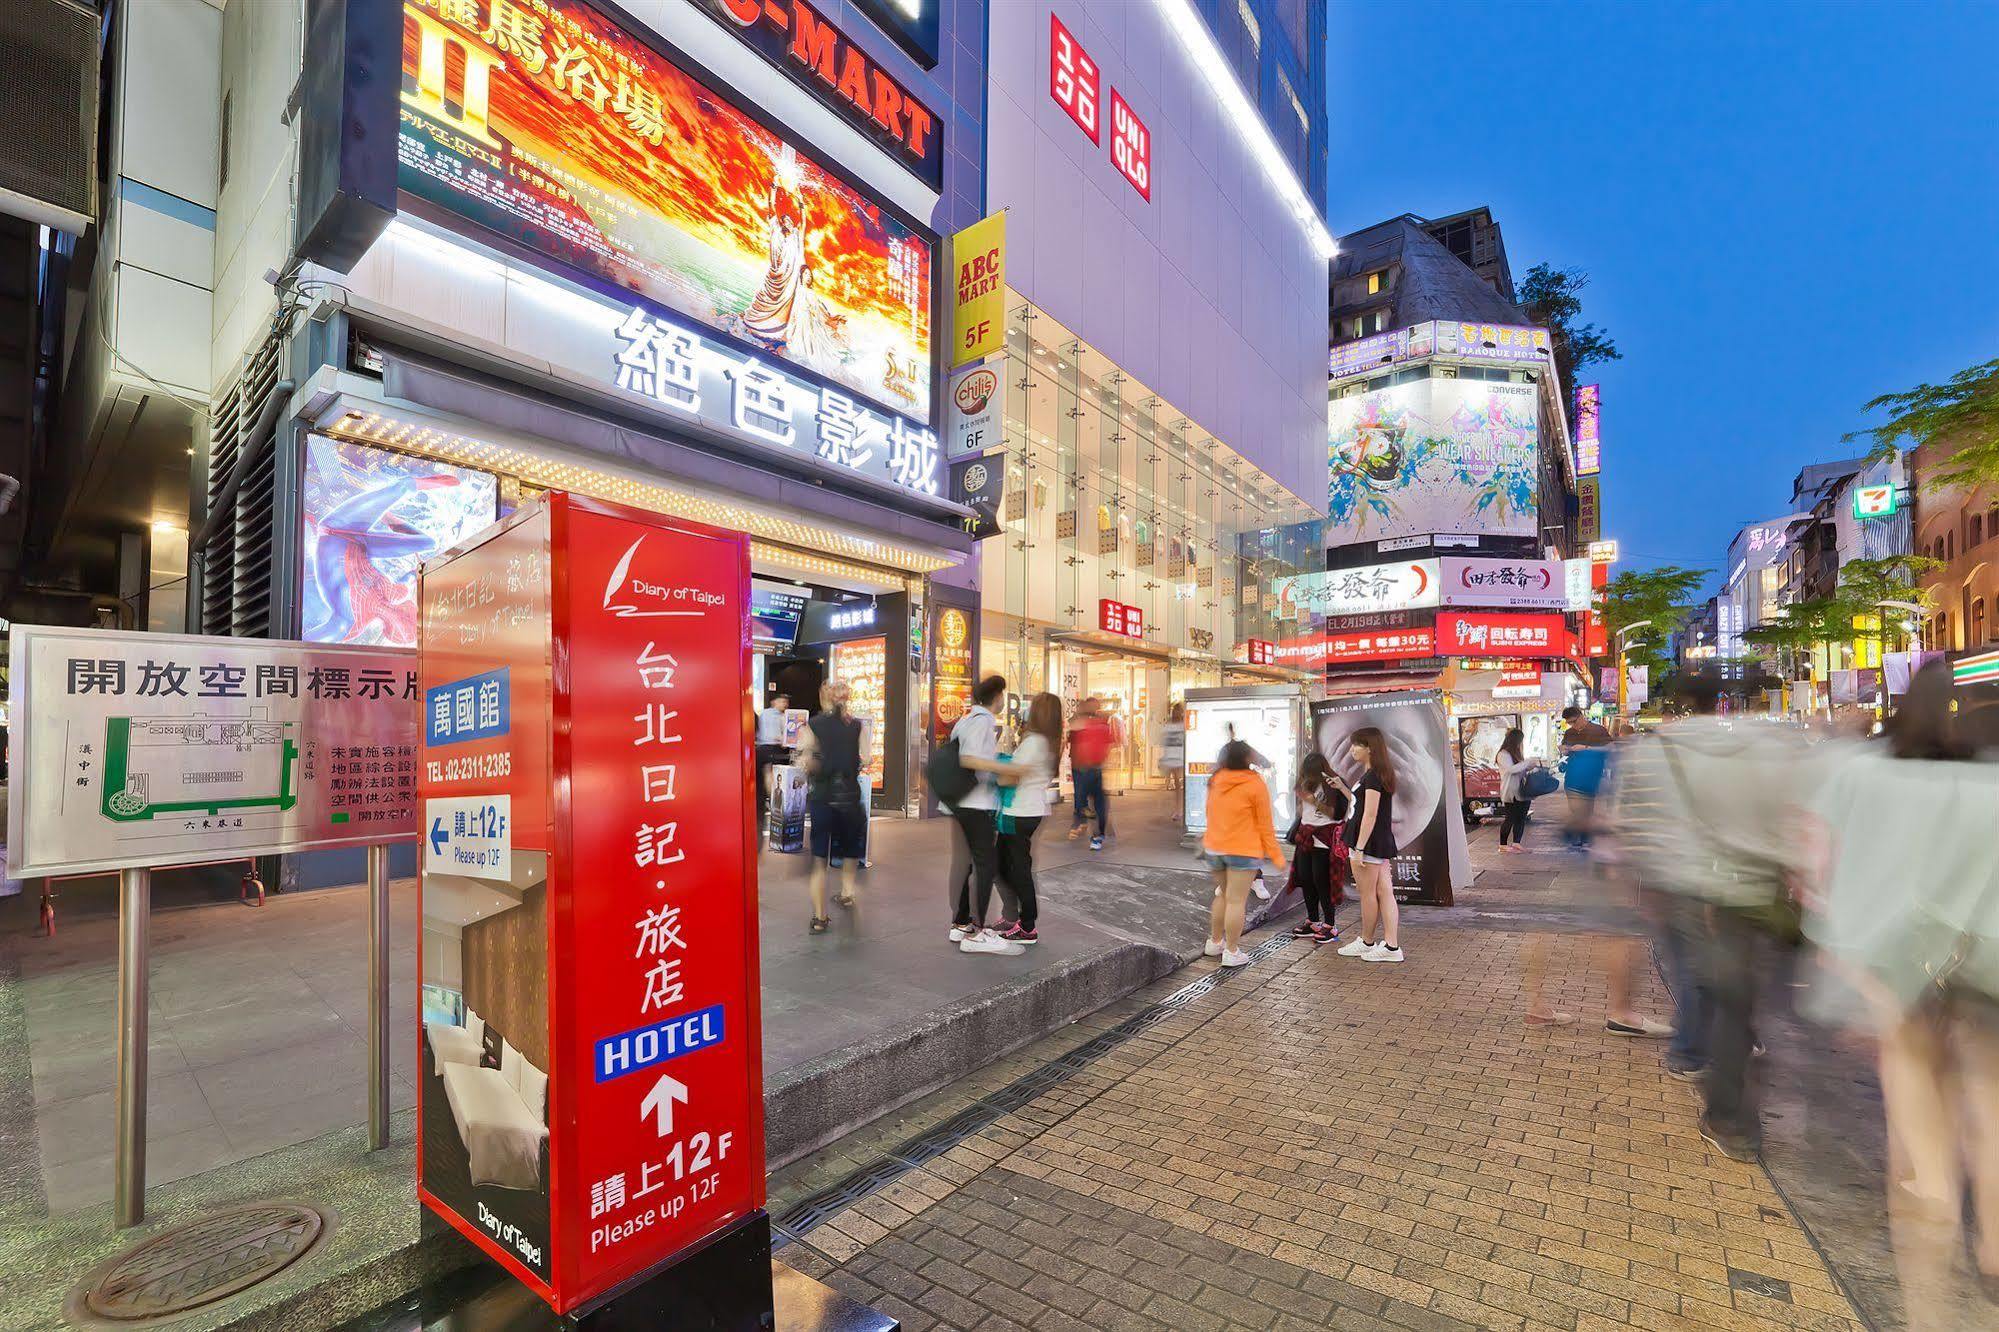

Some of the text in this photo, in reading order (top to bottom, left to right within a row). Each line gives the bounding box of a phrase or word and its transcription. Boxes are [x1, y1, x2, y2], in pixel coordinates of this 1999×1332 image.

[958, 247, 1000, 289] ABC
[958, 273, 1000, 306] MART
[965, 319, 991, 349] 5F
[613, 306, 938, 496] 絕色影城
[1487, 385, 1532, 395] CONVERSE
[966, 430, 984, 449] 6F
[632, 579, 725, 607] Diary of Taipei
[434, 680, 500, 737] 萬國館
[76, 743, 93, 787] 漢中街
[331, 745, 417, 759] 未實施容積
[331, 760, 417, 775] 地區綜合設
[331, 775, 417, 791] 勵辦法設置
[331, 790, 417, 807] 空間供公眾
[454, 847, 500, 869] Please up 12F
[603, 1012, 717, 1076] HOTEL
[591, 1172, 720, 1254] Please up 12F
[477, 1201, 502, 1239] Diary
[513, 1227, 541, 1267] Taipei
